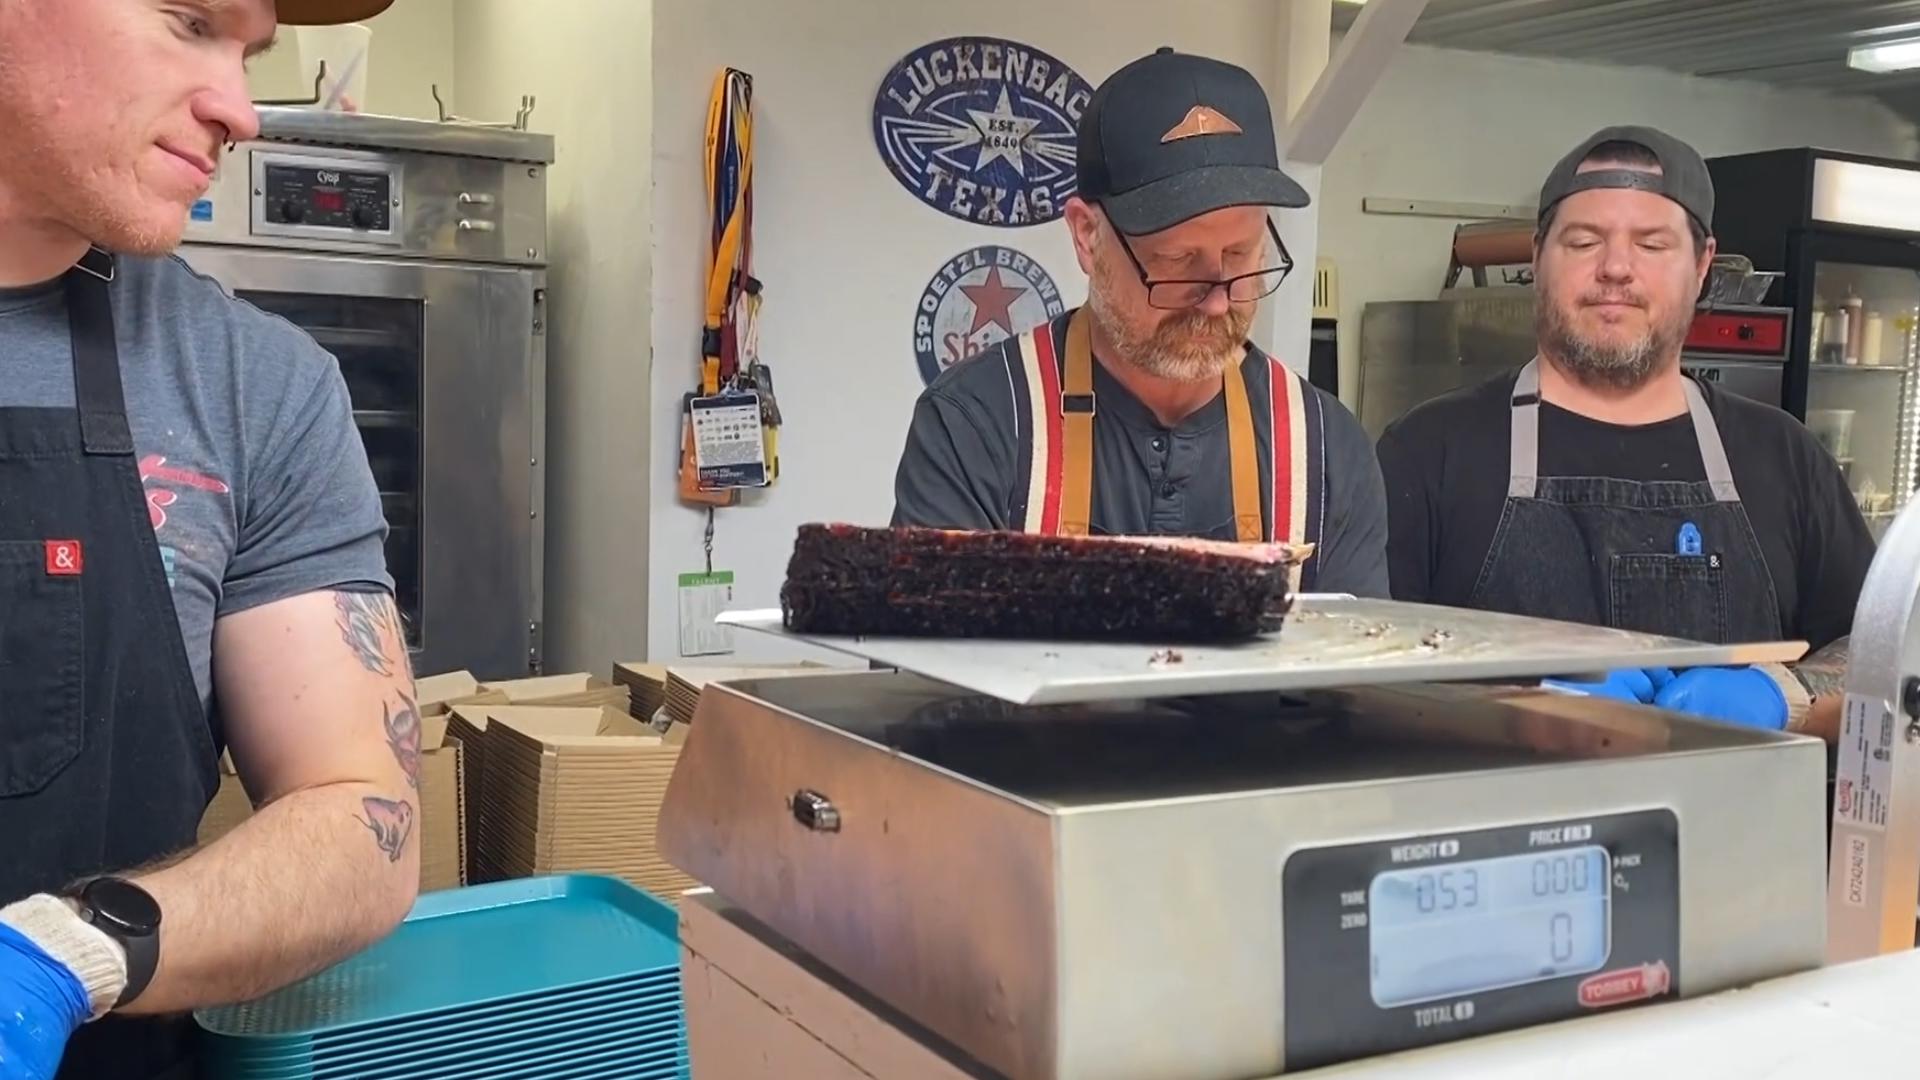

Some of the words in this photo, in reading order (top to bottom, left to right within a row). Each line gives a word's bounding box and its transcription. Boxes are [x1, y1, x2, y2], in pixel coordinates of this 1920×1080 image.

[888, 44, 1091, 119] LUCKENBAC
[988, 118, 1020, 134] EST.
[924, 161, 1054, 224] TEXAS
[916, 249, 987, 353] SPOETZL
[996, 248, 1064, 318] BREWE
[55, 546, 74, 568] &
[1529, 828, 1562, 846] PRICE
[1391, 842, 1438, 863] WEIGHT
[1341, 890, 1366, 906] TARE
[1341, 912, 1368, 929] ZERO
[1415, 1005, 1453, 1028] TOTAL
